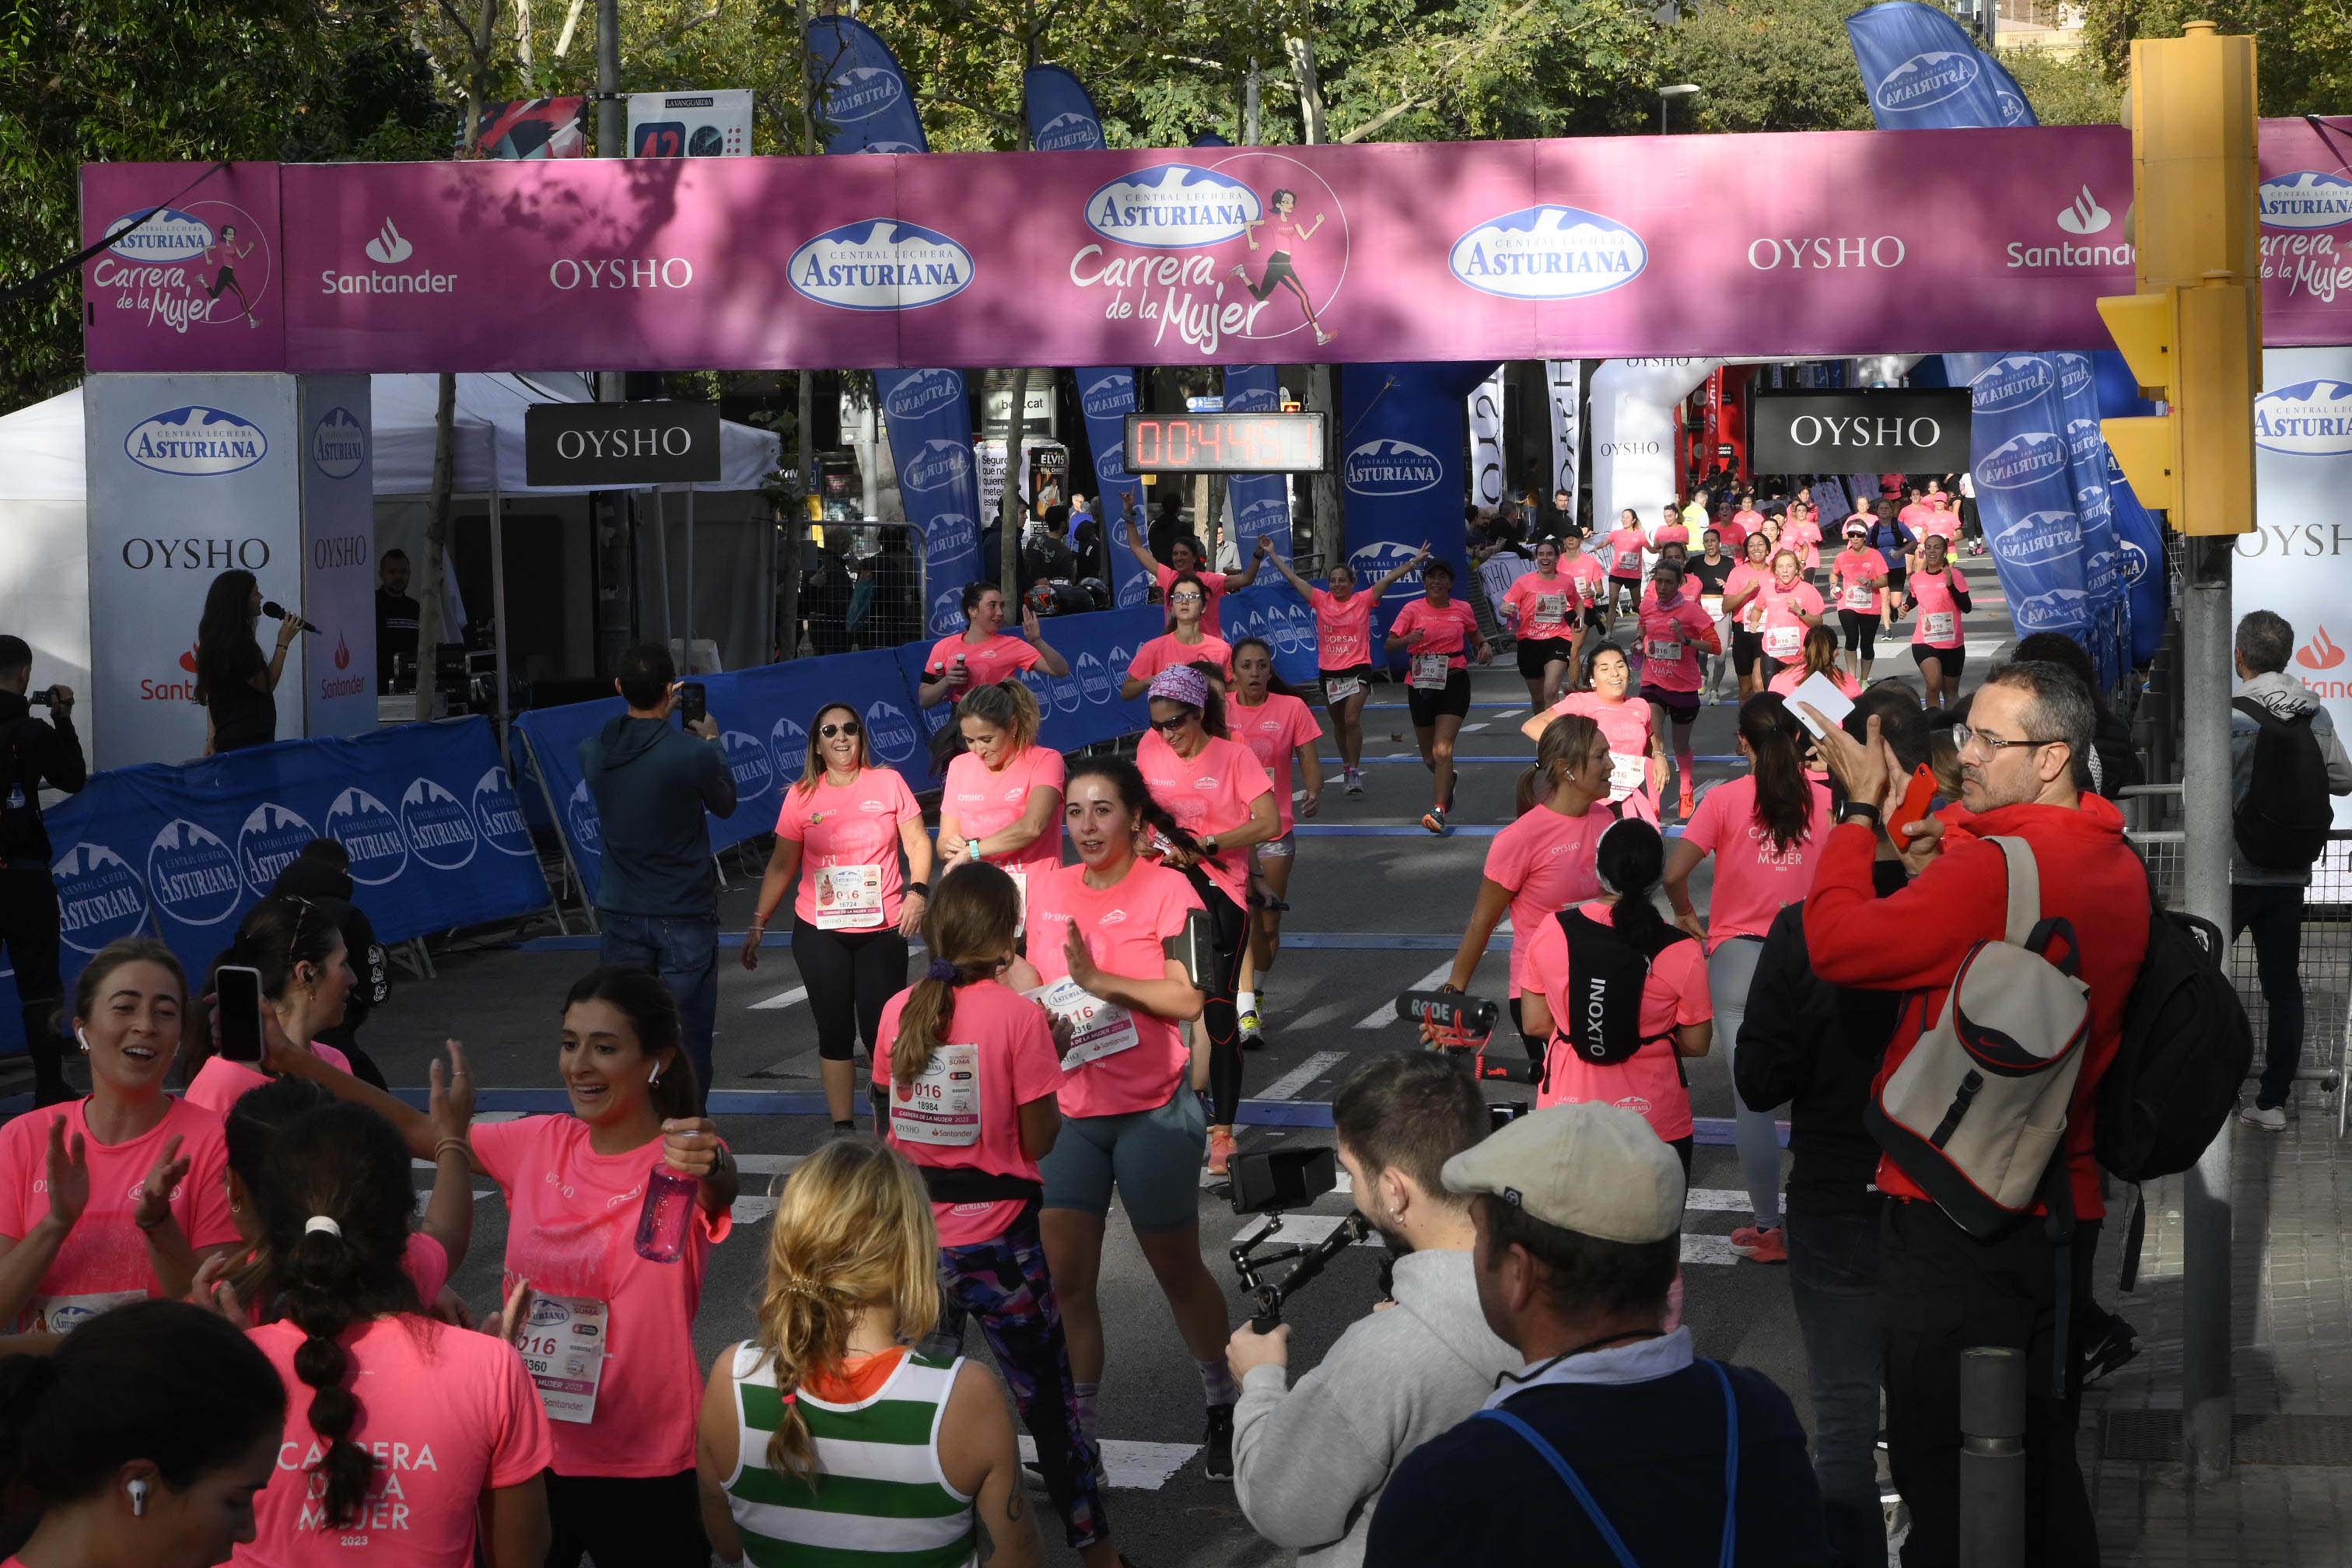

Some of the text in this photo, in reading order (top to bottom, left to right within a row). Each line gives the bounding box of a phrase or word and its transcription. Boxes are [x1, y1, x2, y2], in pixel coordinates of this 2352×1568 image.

[1125, 194, 1182, 202] CENTRAL
[1098, 196, 1246, 227] ASTURIANA
[830, 249, 954, 260] CENTRAL LECHERA
[1748, 235, 1906, 271] OYSHO
[2260, 233, 2334, 256] arrera
[1069, 243, 1216, 288] Carrera
[1464, 242, 1632, 276] ASTURIANA
[2278, 257, 2292, 278] la
[94, 259, 187, 288] Carrera
[321, 270, 457, 294] Santander
[550, 257, 693, 290] OYSHO
[802, 254, 960, 288] ASTURIANA
[117, 285, 220, 333] de la Mujer
[1105, 282, 1269, 355] de la Mujer
[2276, 406, 2328, 415] CENTRAL
[1790, 415, 1941, 447] OYSHO
[135, 432, 257, 459] ASTURIANA
[317, 436, 362, 461] ASTURIANA
[557, 427, 691, 460] OYSHO
[1601, 441, 1660, 457] OYSHO
[1041, 454, 1065, 464] ELVIS
[982, 467, 996, 477] que
[1348, 462, 1435, 483] ASTURIANA
[122, 538, 270, 569] OYSHO
[314, 535, 366, 569] OYSHO
[1325, 634, 1357, 643] DORSAL
[1326, 645, 1349, 654] SUMA
[321, 674, 365, 699] Santander
[408, 814, 474, 849] ASTURIANA
[1551, 842, 1580, 855] OYSHO
[1757, 853, 1803, 865] MUJER
[157, 863, 238, 904] ASTURIANA
[1091, 1029, 1110, 1039] MUJER
[1101, 1035, 1130, 1048] Santander
[915, 1082, 941, 1098] 016
[898, 1111, 919, 1119] CARRERA
[918, 1101, 938, 1111] 18984
[896, 1123, 919, 1134] OYSHO
[573, 1307, 598, 1316] SUMA
[517, 1335, 556, 1355] 016
[538, 1379, 583, 1391] MUJER 2023
[544, 1398, 583, 1411] Santander
[277, 1440, 438, 1472] CAERA
[299, 1503, 409, 1531] MJER
